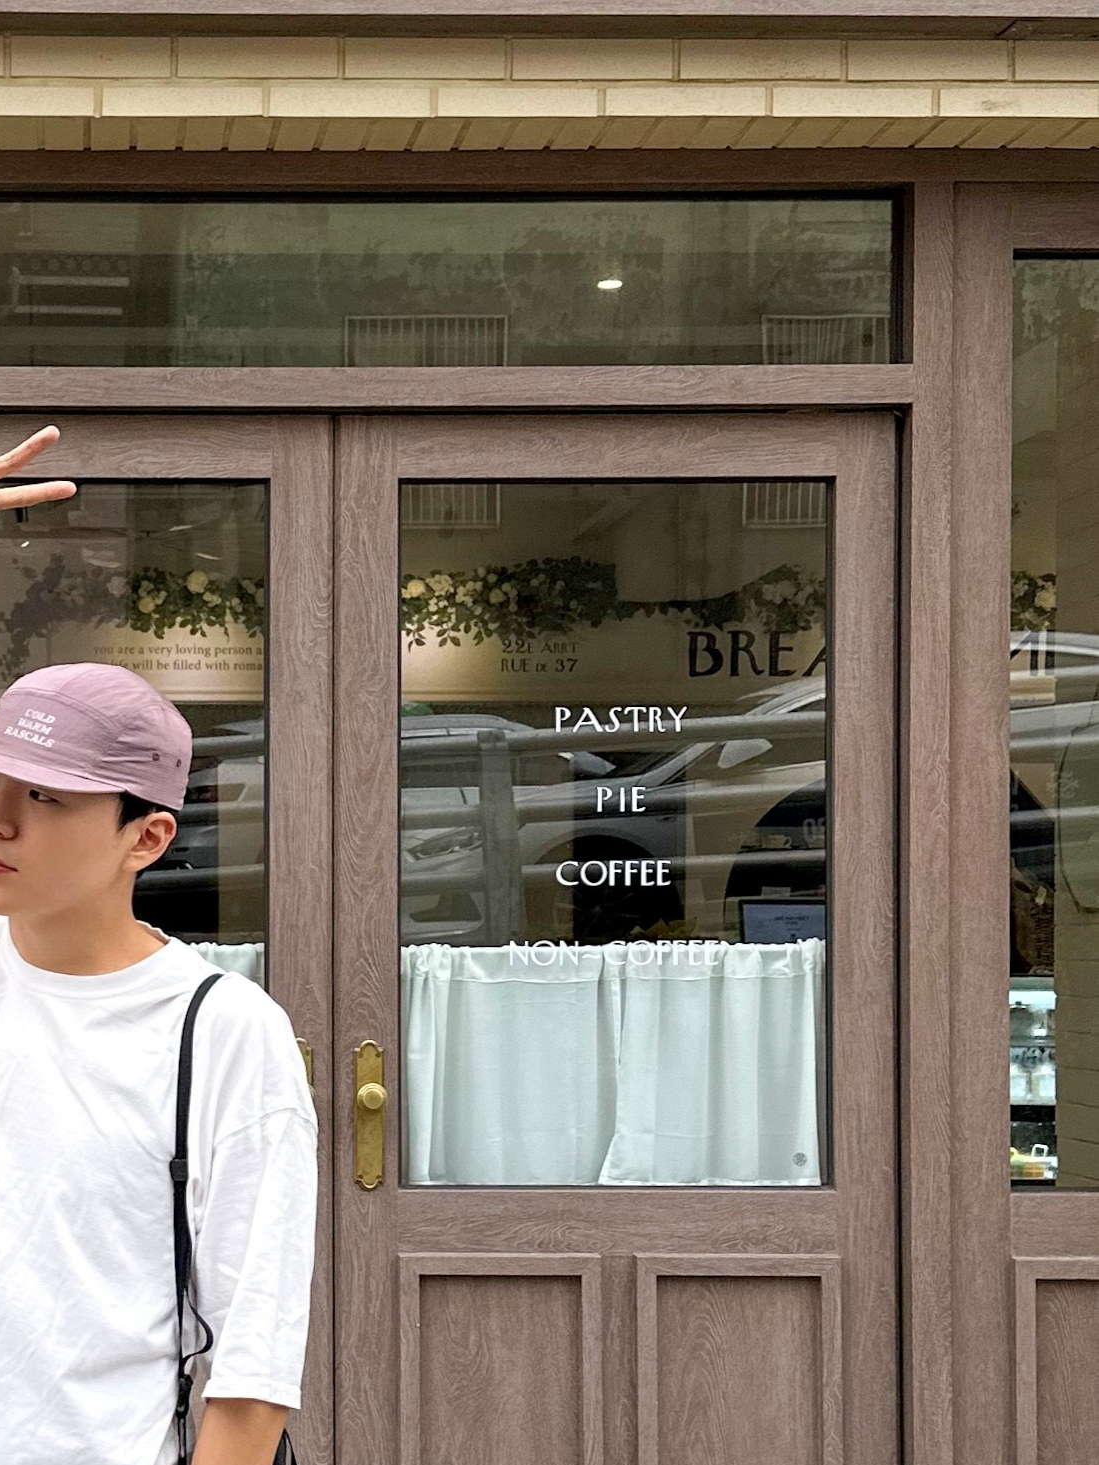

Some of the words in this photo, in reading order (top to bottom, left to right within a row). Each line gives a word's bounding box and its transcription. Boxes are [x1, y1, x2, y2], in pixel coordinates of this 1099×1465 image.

[93, 646, 113, 655] you
[117, 646, 135, 655] are
[138, 646, 144, 655] a
[148, 646, 173, 657] very
[176, 643, 211, 657] loving
[214, 646, 252, 658] person
[132, 659, 152, 670] will
[157, 659, 170, 670] be
[173, 659, 201, 670] filled
[205, 660, 230, 670] with
[555, 659, 578, 673] 37
[25, 708, 56, 724] COLD
[555, 706, 688, 733] PASTRY
[18, 717, 53, 735] WARM
[3, 725, 56, 748] RASCALS
[596, 786, 646, 812] PIE
[556, 860, 671, 886] COFFEE
